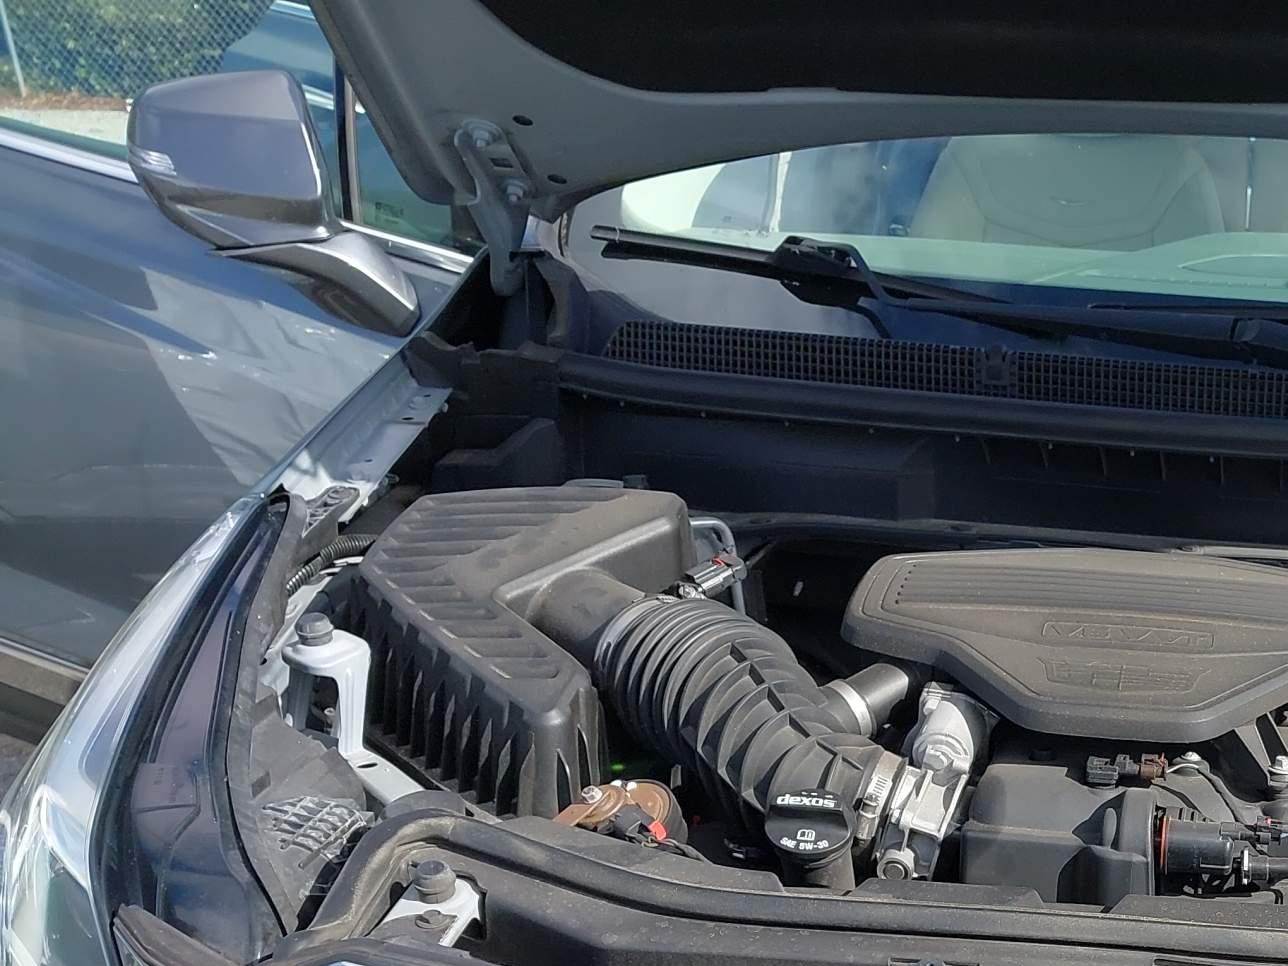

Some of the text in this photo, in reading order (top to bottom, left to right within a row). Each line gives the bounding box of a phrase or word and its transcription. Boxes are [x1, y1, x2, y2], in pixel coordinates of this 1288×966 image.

[776, 794, 835, 808] dexos
[780, 837, 829, 850] SAE 5W-30
